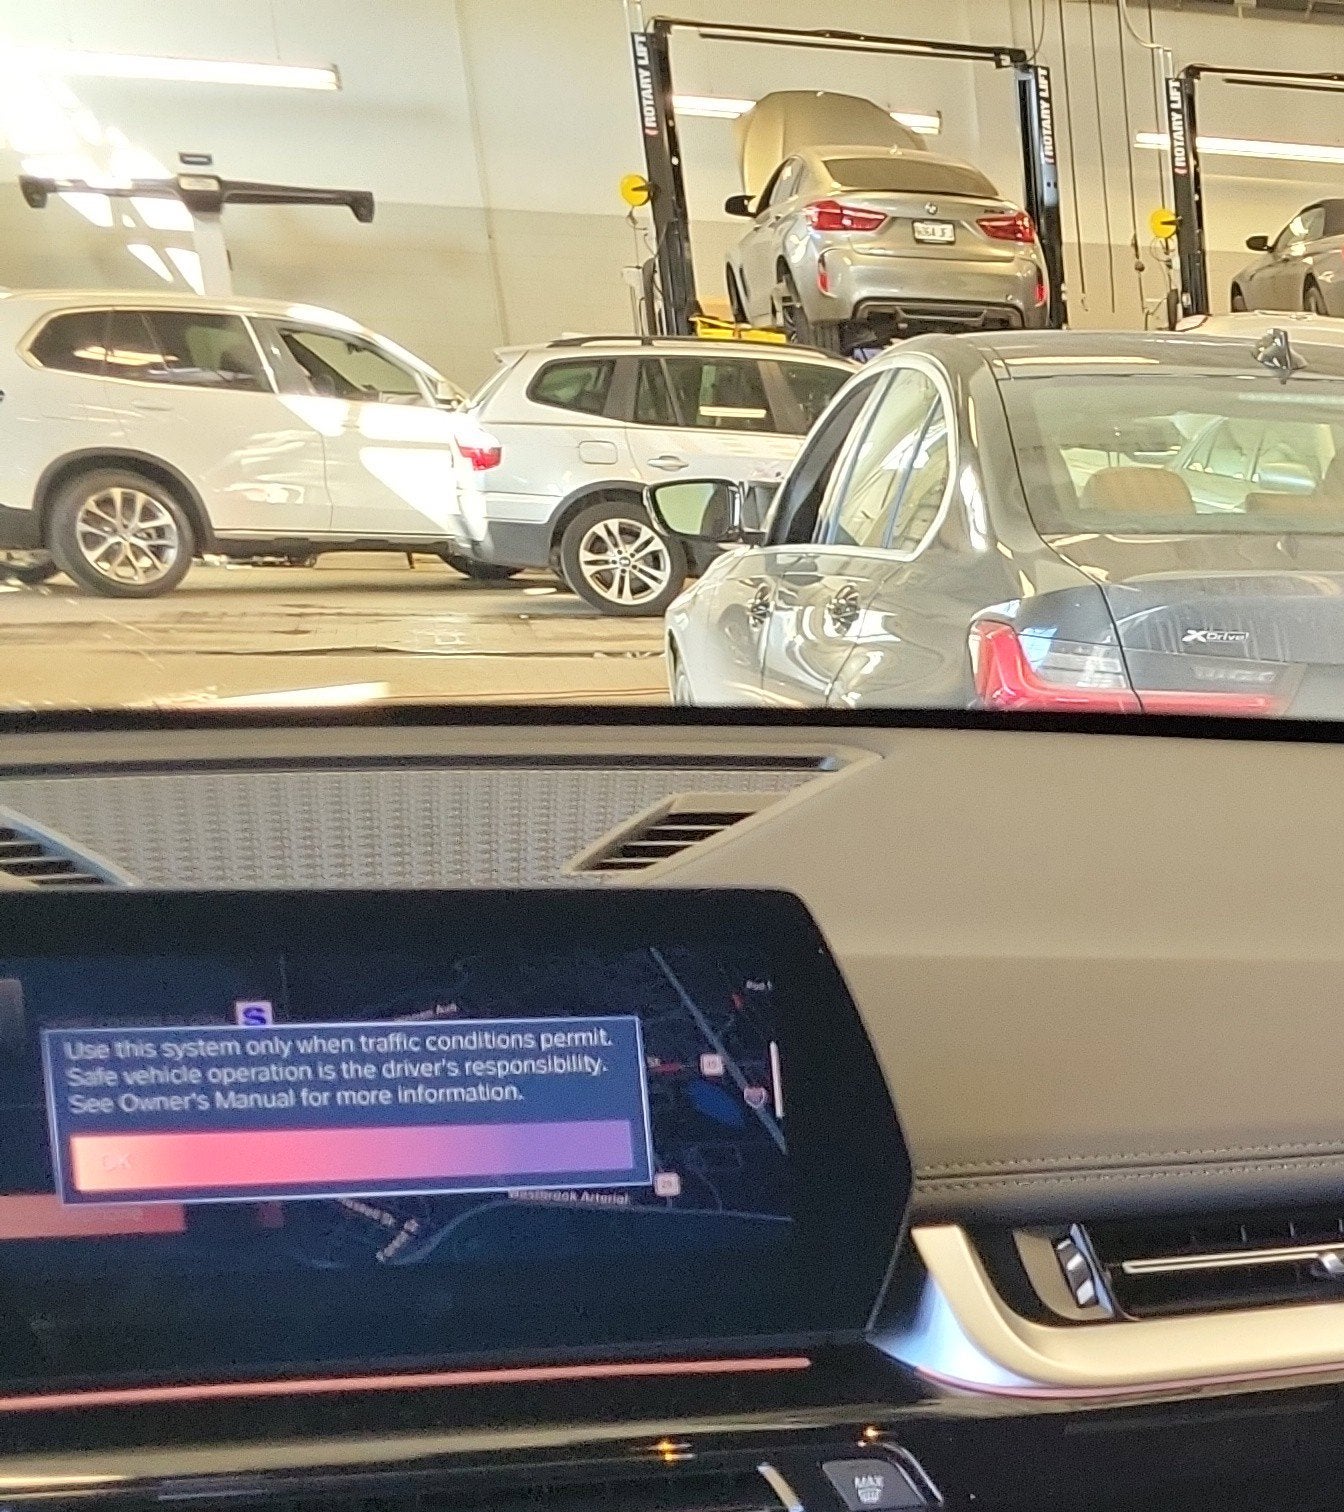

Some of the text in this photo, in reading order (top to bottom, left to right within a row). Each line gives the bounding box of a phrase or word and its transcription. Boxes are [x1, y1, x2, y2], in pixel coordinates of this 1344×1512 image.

[634, 33, 650, 65] LIFT
[1037, 67, 1050, 98] LIFT
[1168, 79, 1187, 167] ROTARY LIFT
[64, 1027, 614, 1061] Use this system only when traffic conditions permit.
[67, 1054, 609, 1087] Safe vehicle operation is the driver's responsibility.
[70, 1083, 525, 1114] See Owner's Manual for more information.
[854, 1474, 885, 1489] MAX
